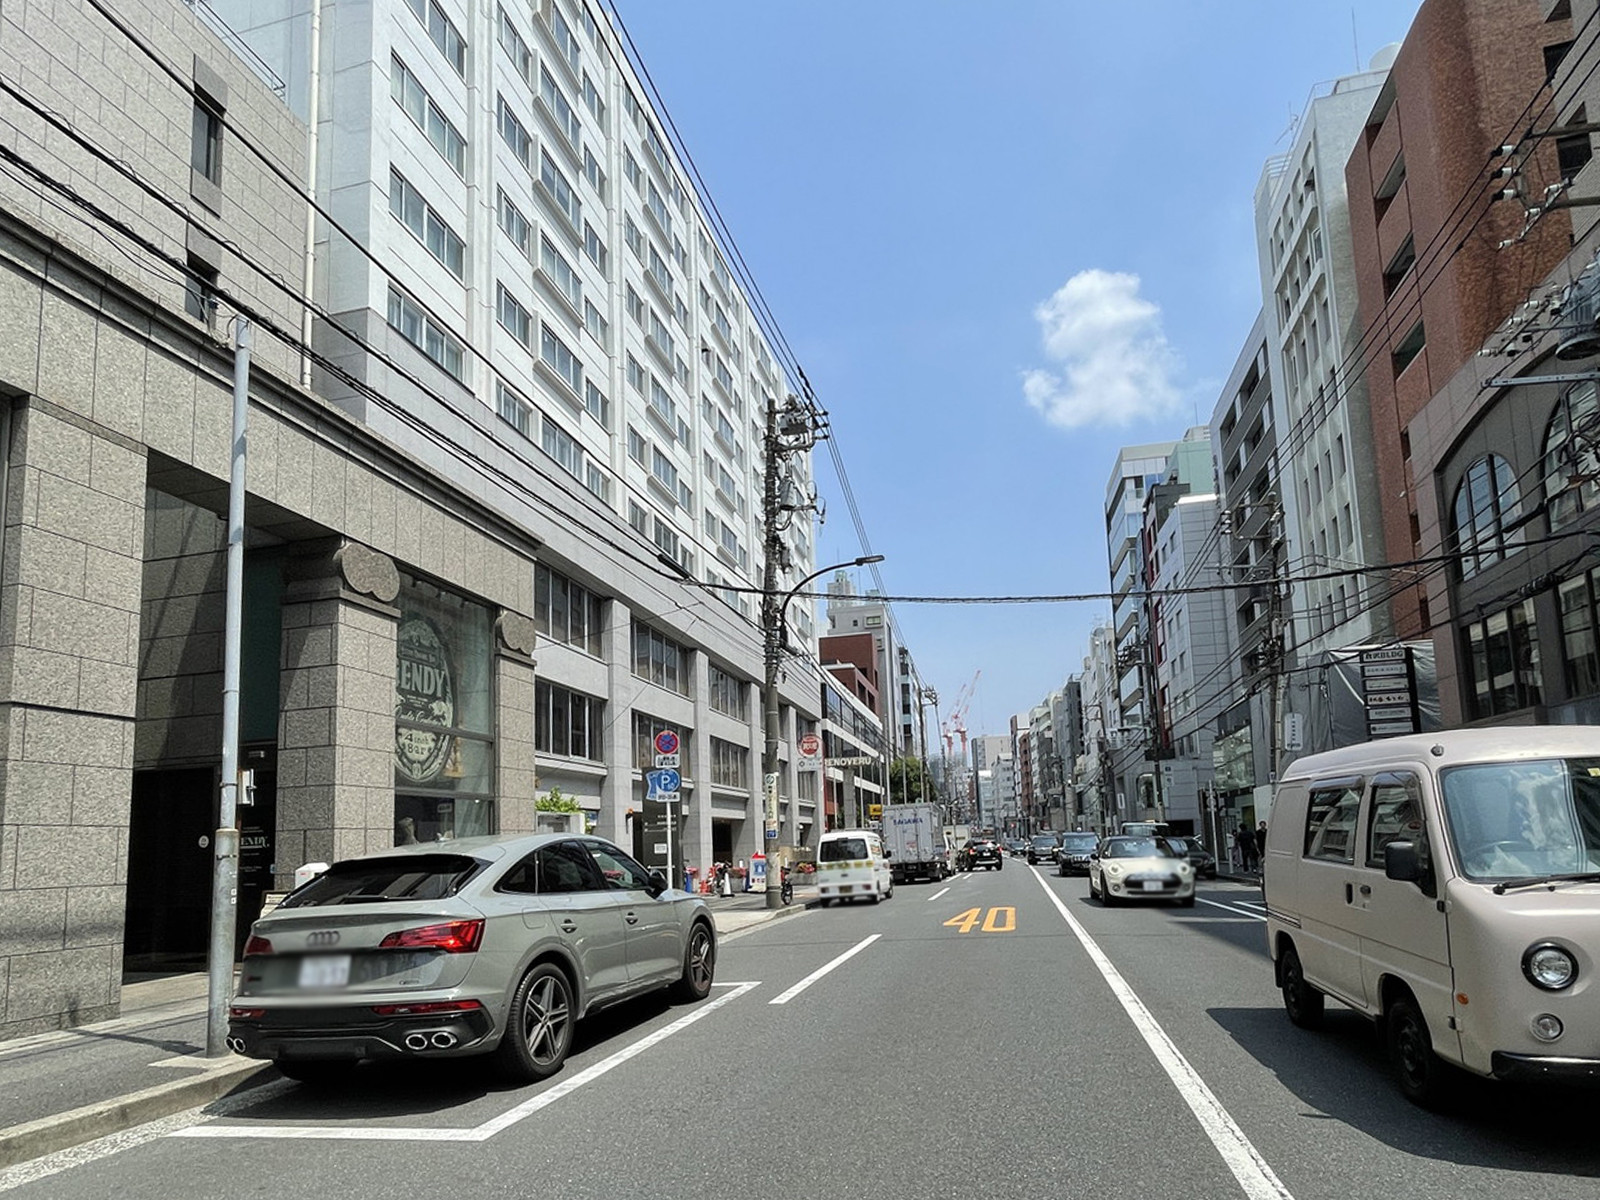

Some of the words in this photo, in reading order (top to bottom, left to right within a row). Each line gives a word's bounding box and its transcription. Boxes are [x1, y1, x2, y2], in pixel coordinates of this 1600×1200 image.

[396, 659, 445, 697] ENDY
[661, 775, 671, 789] P
[943, 907, 1016, 934] 40
